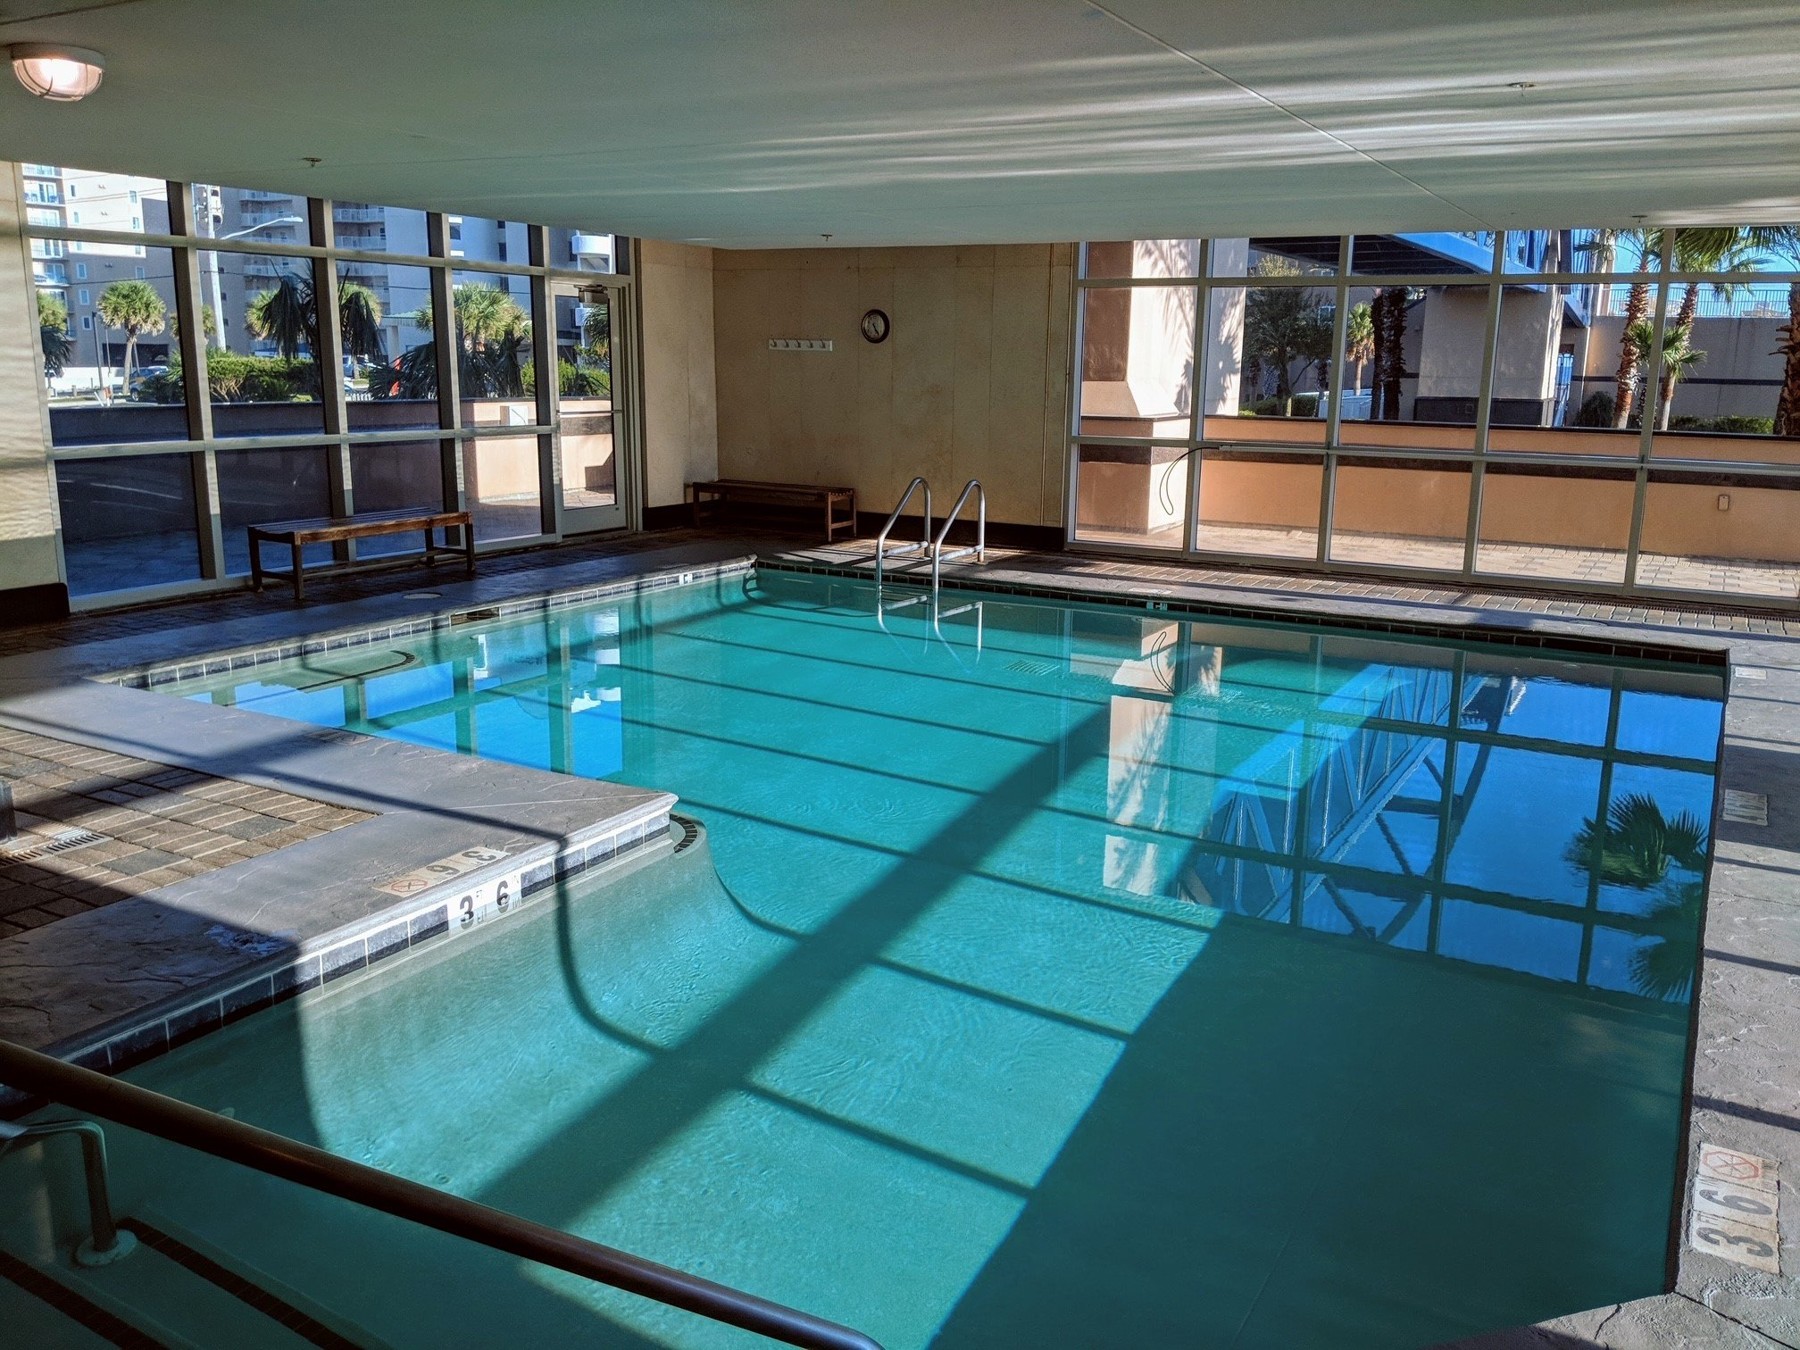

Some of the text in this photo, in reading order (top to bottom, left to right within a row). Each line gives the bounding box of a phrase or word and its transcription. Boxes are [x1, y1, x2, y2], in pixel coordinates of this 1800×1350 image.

[425, 850, 497, 876] 3 6
[459, 895, 475, 925] 3
[496, 880, 511, 909] 6
[1699, 1188, 1773, 1216] 6
[1696, 1226, 1774, 1258] 3
